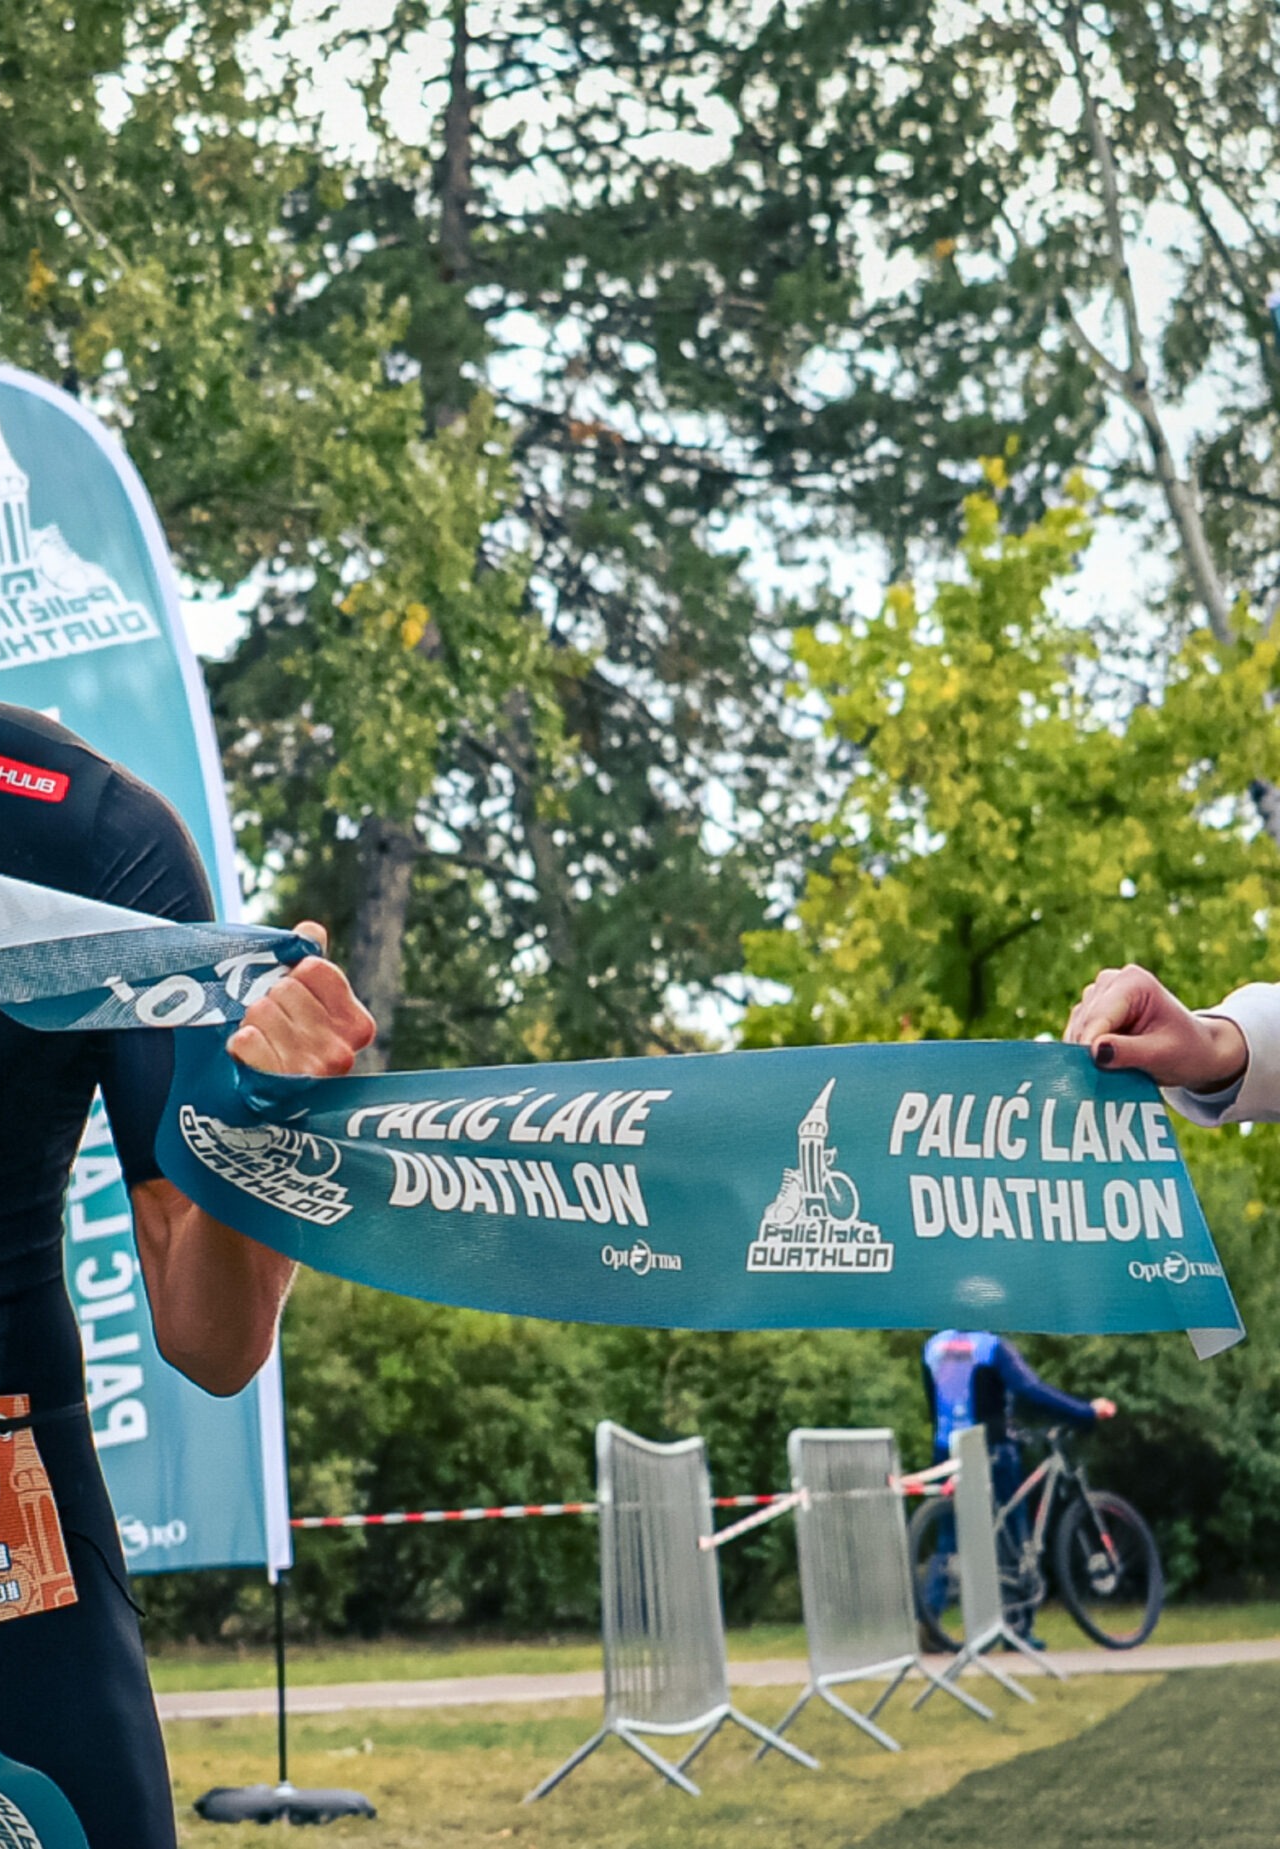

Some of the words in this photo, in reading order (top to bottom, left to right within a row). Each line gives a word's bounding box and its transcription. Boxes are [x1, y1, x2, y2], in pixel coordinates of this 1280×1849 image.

[347, 1087, 536, 1142] PALIĆ
[509, 1090, 672, 1145] LAKE
[889, 1081, 1032, 1160] PALIĆ
[1041, 1098, 1177, 1162] LAKE
[182, 1109, 343, 1221] DUATHLON
[384, 1148, 649, 1227] DUATHLON
[909, 1174, 1184, 1241] DUATHLON
[751, 1246, 890, 1268] DUATHLON
